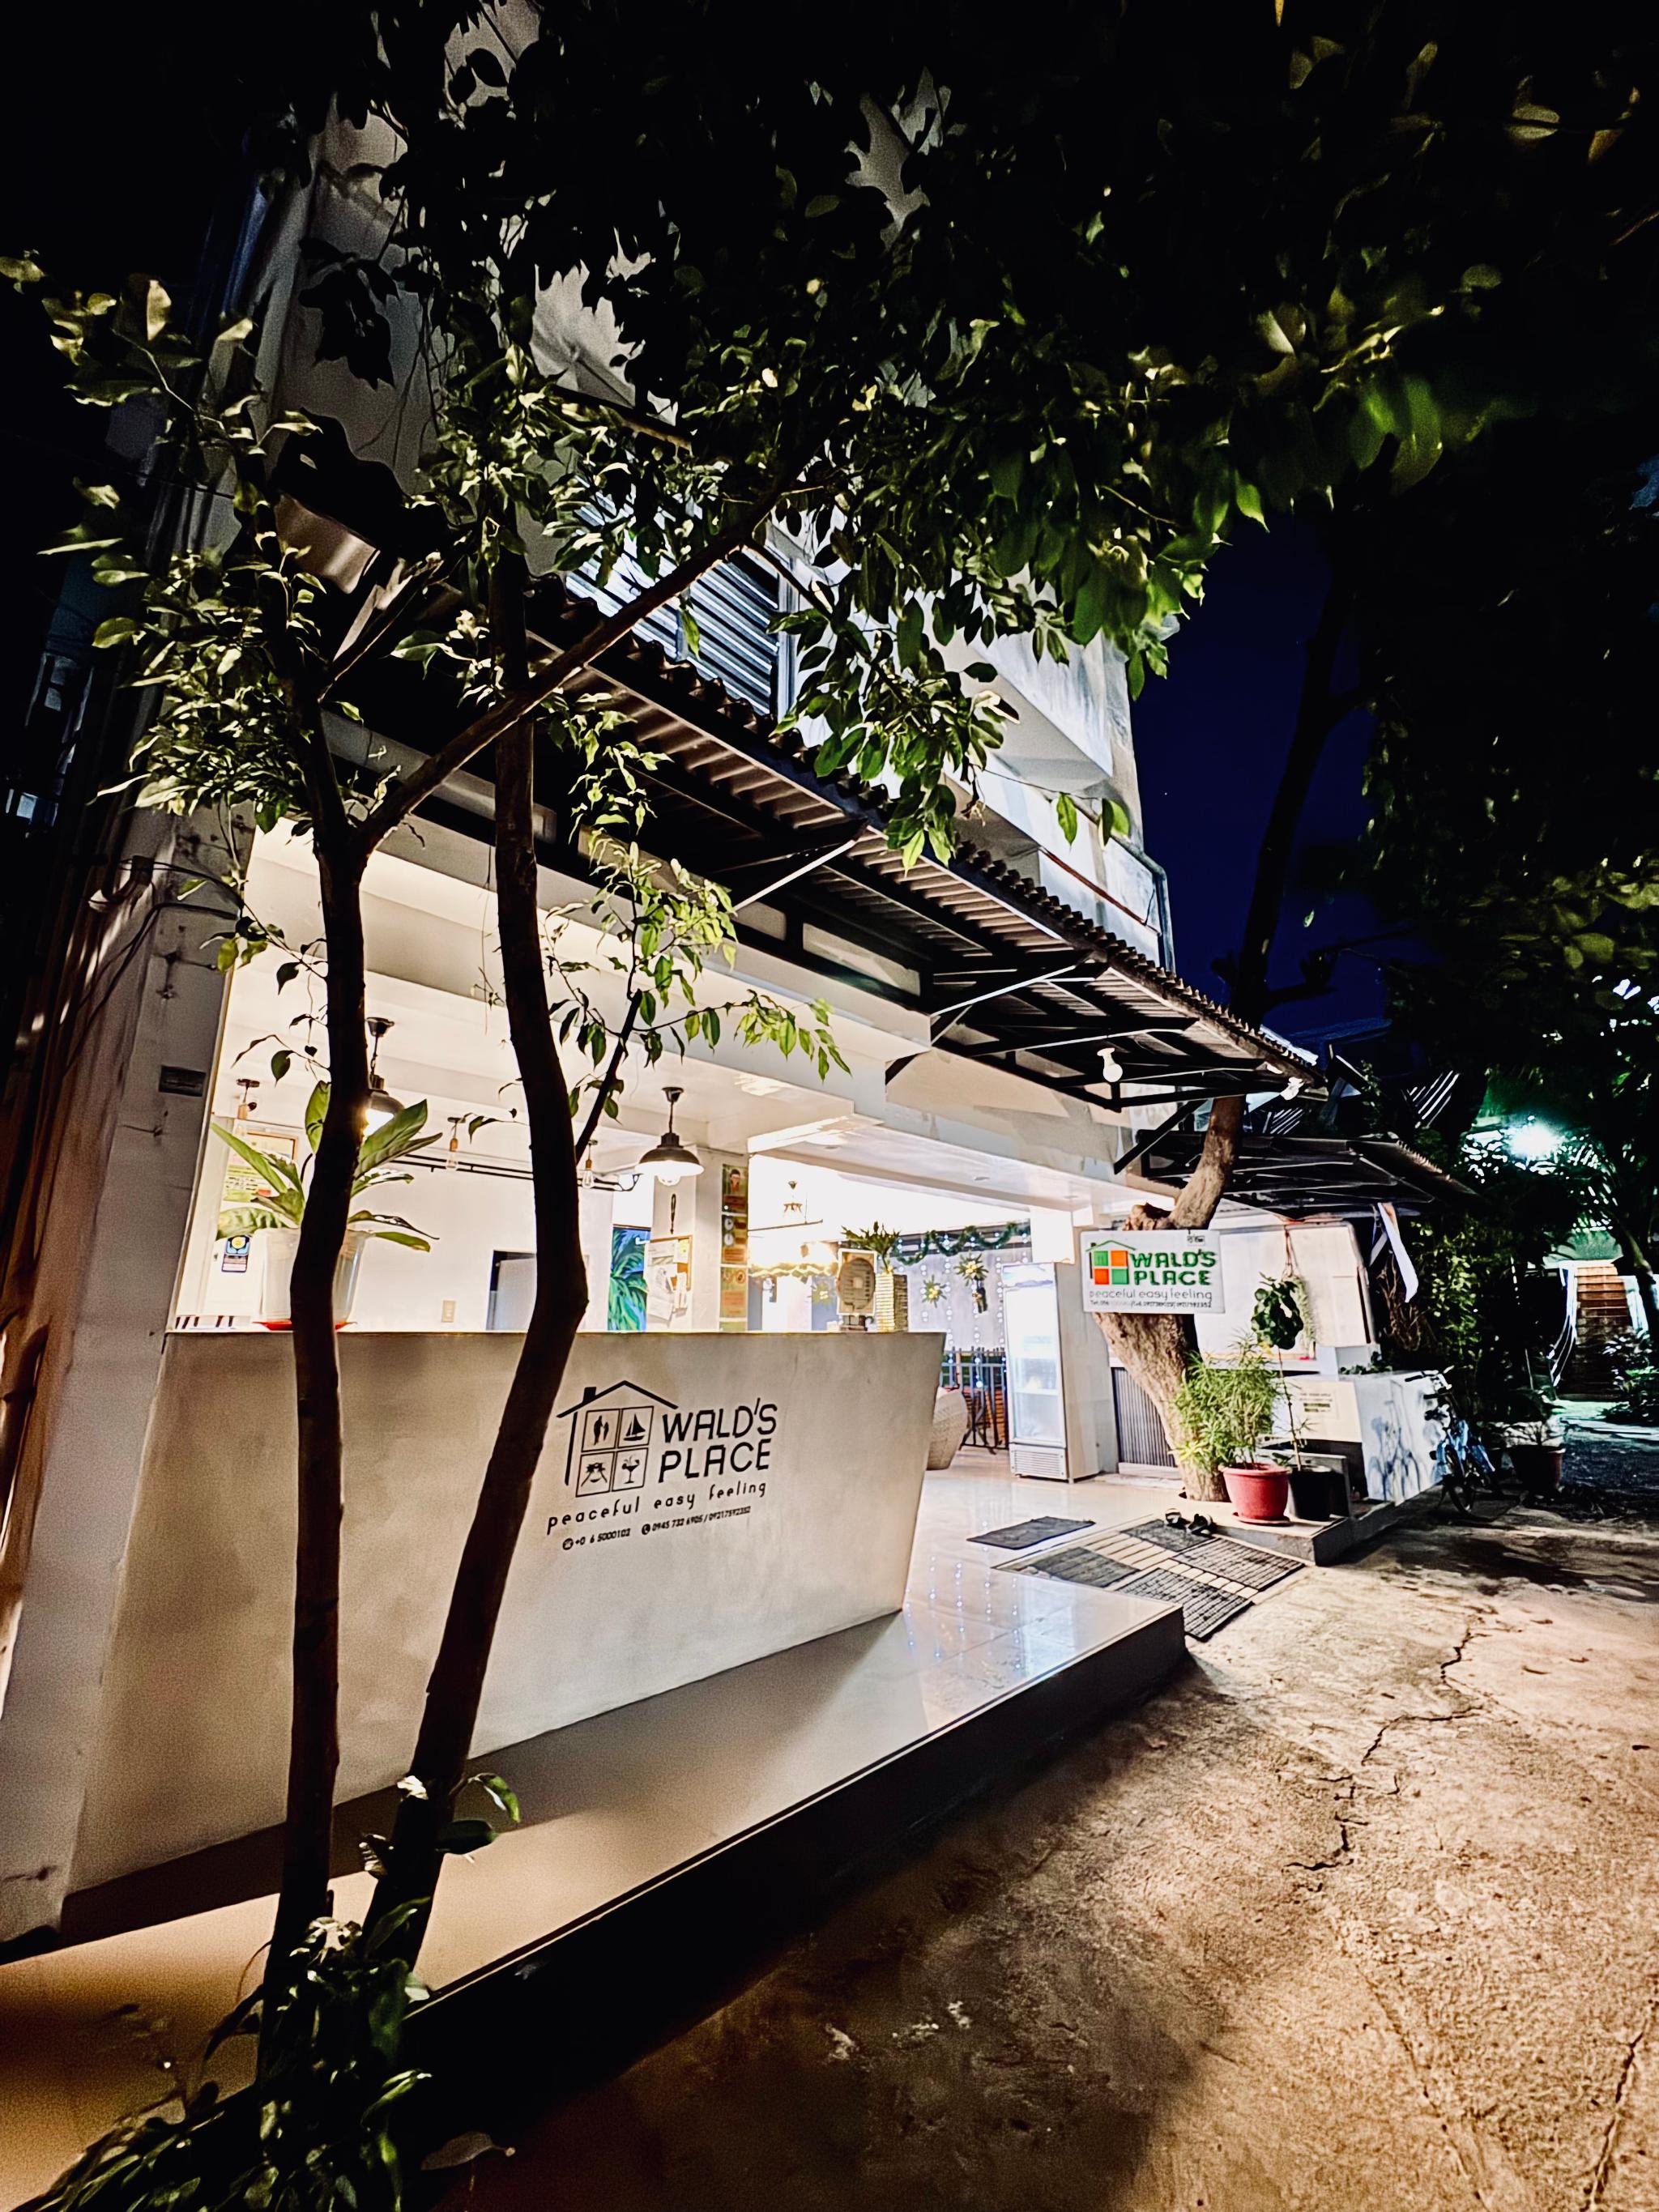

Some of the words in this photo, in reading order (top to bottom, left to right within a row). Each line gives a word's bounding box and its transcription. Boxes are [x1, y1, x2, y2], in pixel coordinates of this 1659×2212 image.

[1129, 1248, 1217, 1268] WALD'S
[1133, 1270, 1212, 1286] PLACE
[1089, 1288, 1136, 1298] peaceful
[1138, 1290, 1168, 1300] easy
[1170, 1288, 1213, 1303] feeling
[662, 1397, 778, 1443] WALD'S
[658, 1438, 772, 1483] PLACE
[547, 1495, 640, 1535] peaceful
[654, 1492, 696, 1511] easy
[709, 1481, 767, 1499] feeling
